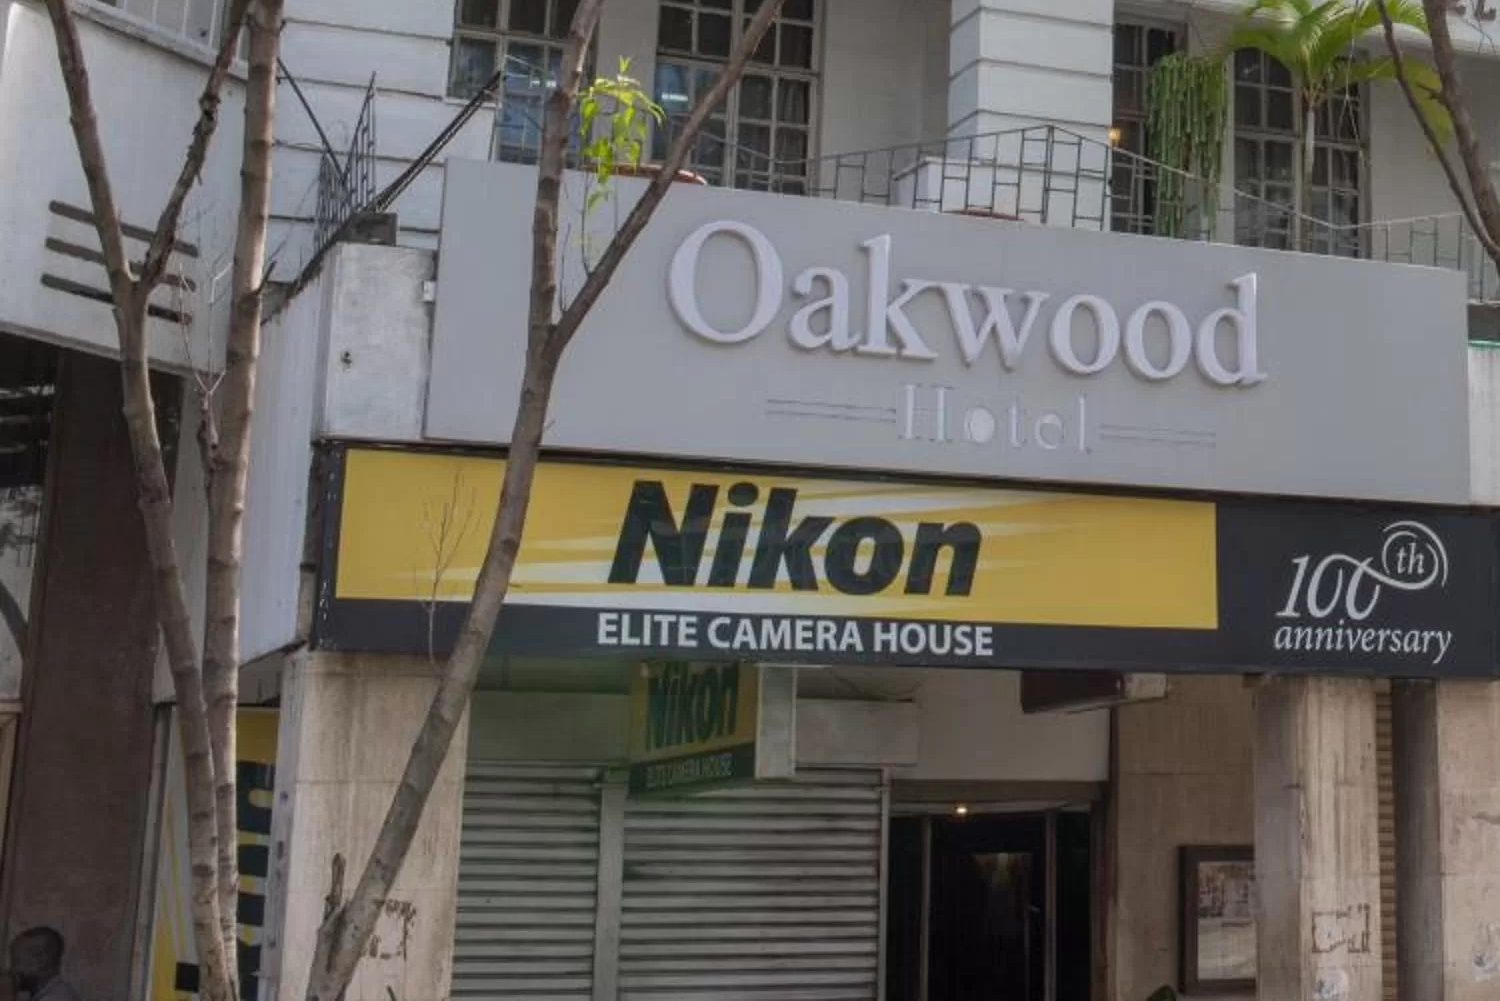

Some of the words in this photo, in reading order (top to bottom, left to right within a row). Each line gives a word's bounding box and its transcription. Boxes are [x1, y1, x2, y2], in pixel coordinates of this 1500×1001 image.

[668, 220, 1268, 387] Oakwood
[899, 383, 1092, 454] Hotel
[607, 480, 983, 596] Nikon
[597, 612, 698, 648] ELITE
[707, 617, 864, 653] CAMERA
[873, 622, 994, 657] HOUSE
[1273, 619, 1453, 665] anniversary
